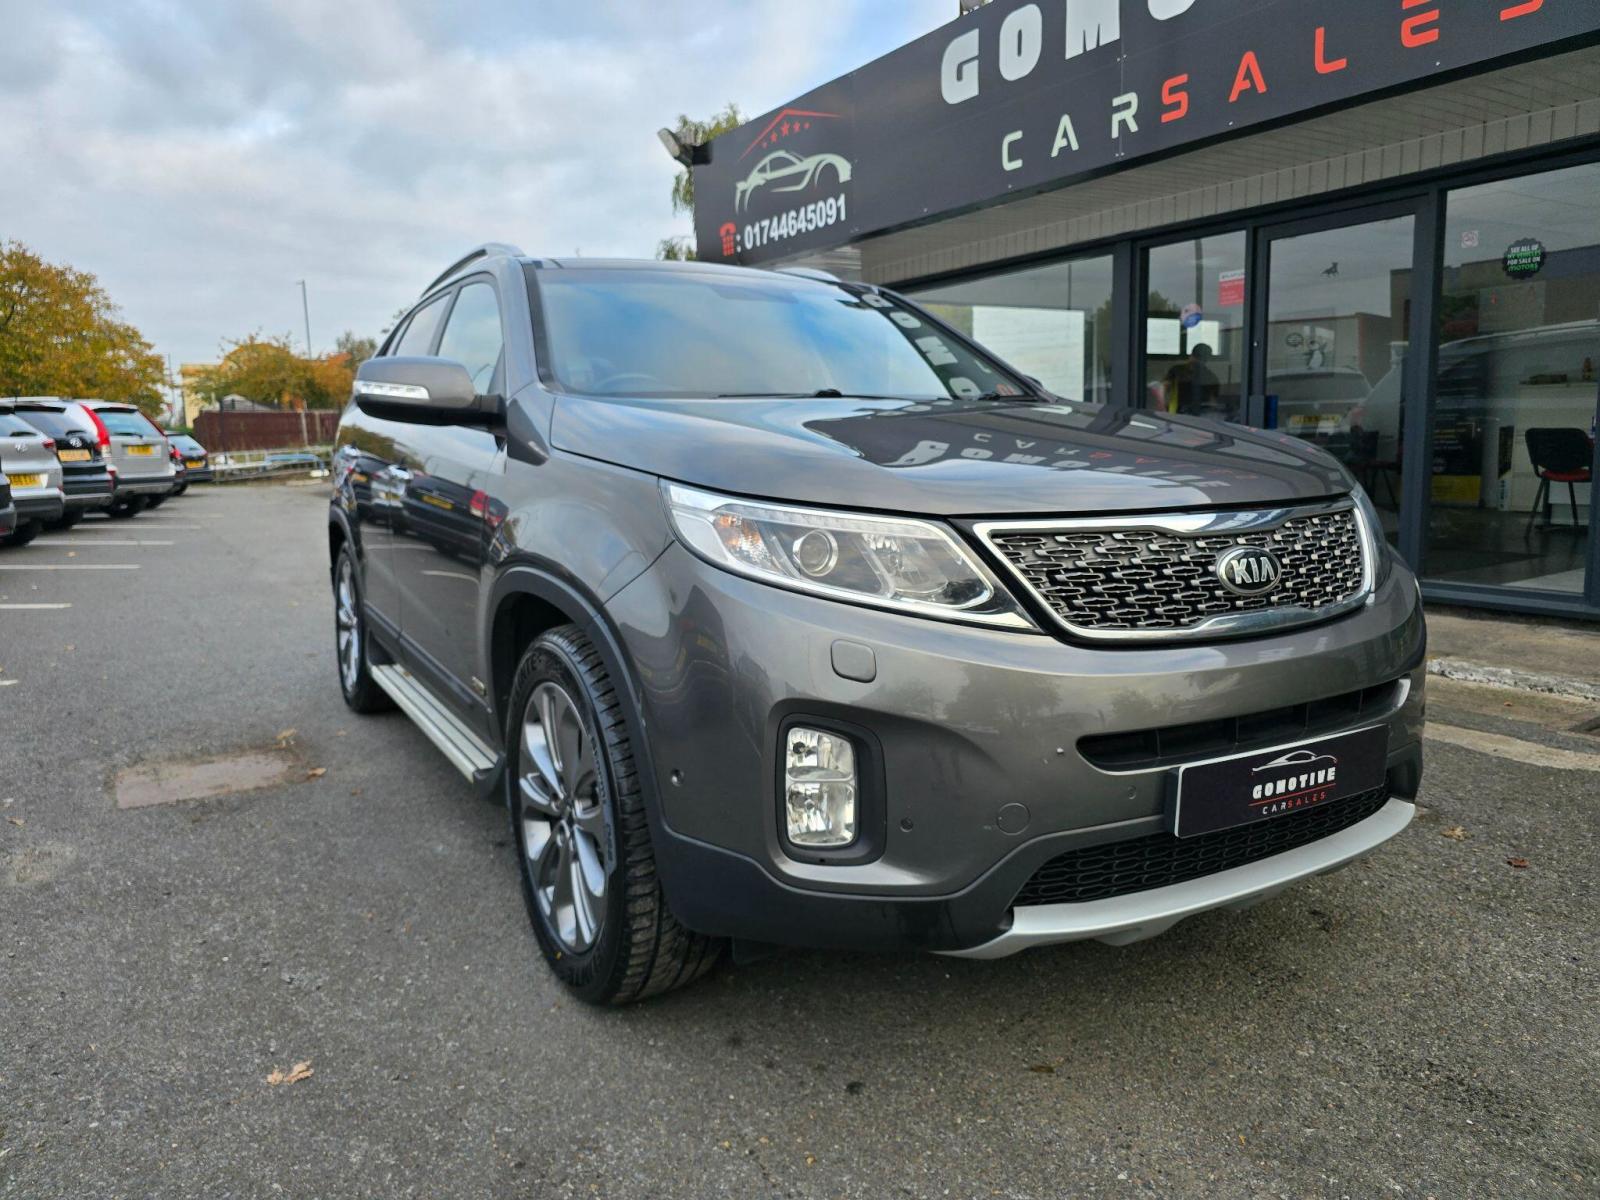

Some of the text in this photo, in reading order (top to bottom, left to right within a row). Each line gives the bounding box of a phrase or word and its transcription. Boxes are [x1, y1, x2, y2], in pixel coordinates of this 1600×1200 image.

[941, 0, 1196, 105] GOM
[1231, 556, 1276, 585] KIA
[1252, 766, 1336, 800] GOMOTIVE
